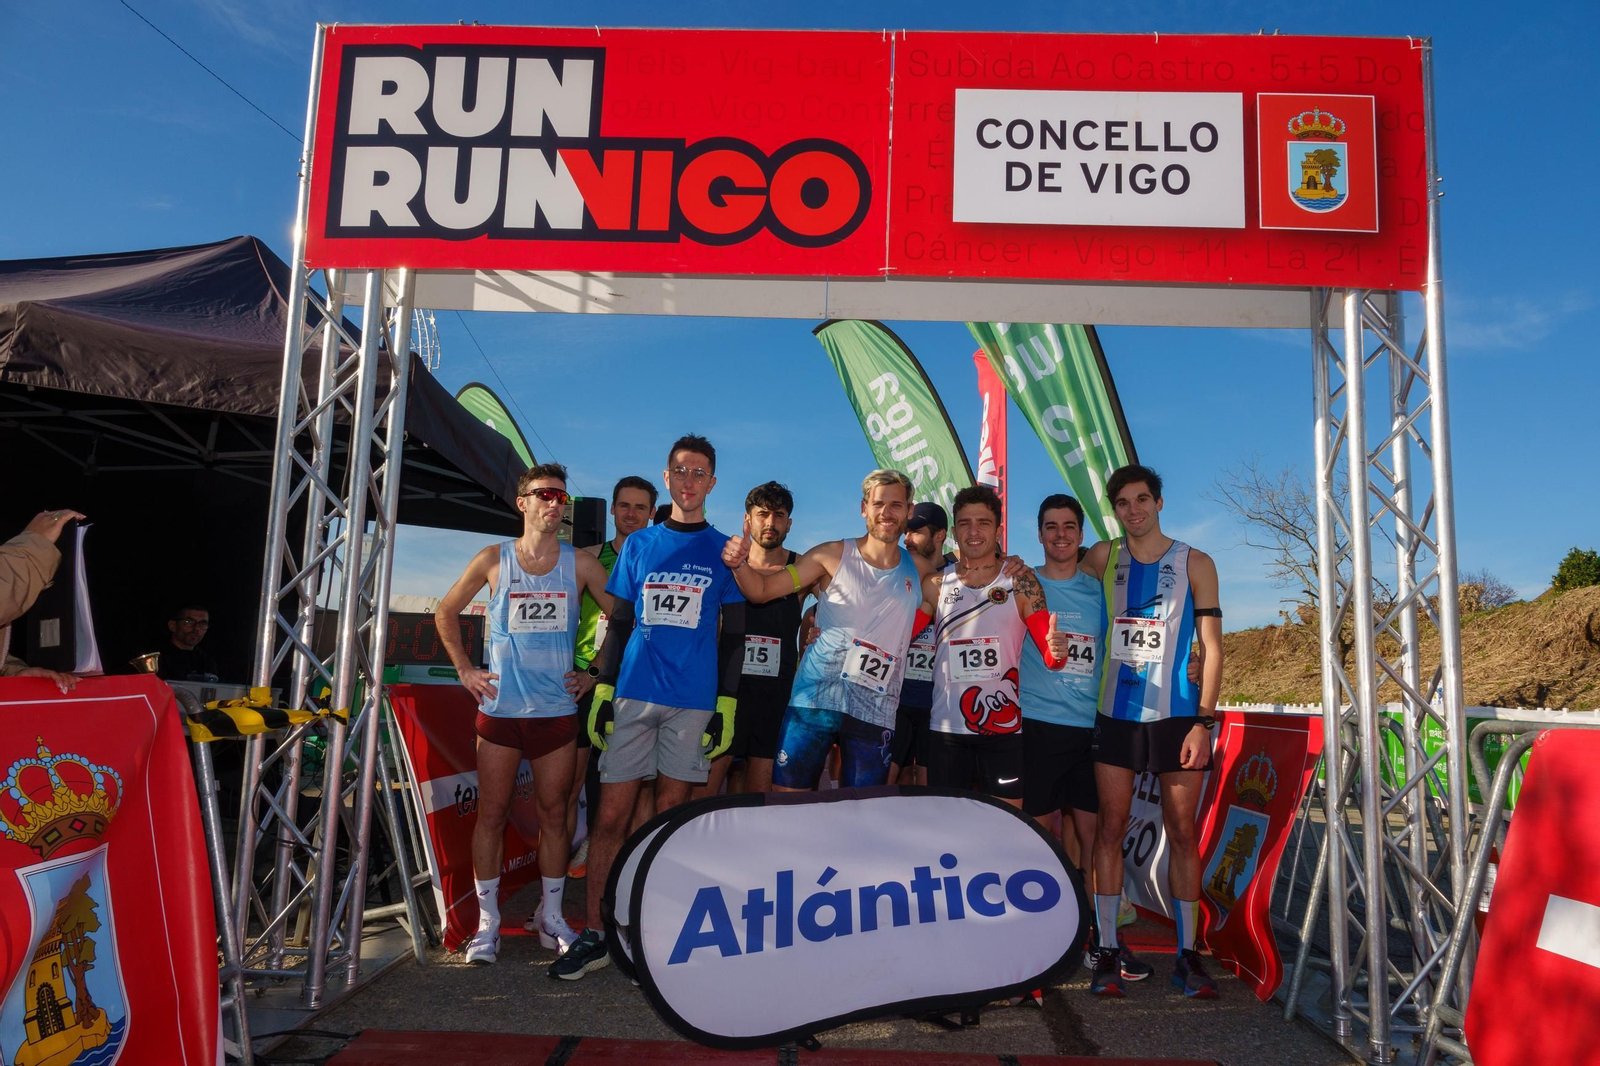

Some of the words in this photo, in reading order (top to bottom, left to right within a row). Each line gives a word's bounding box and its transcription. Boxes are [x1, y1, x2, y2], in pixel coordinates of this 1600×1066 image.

[908, 49, 1037, 80] Subida
[1050, 52, 1096, 80] Ao
[1111, 51, 1235, 82] Castro
[1269, 54, 1339, 84] 5+5
[1353, 56, 1401, 86] Do
[347, 56, 595, 138] RUN
[975, 118, 1219, 154] CONCELLO
[1004, 161, 1062, 193] DE
[1079, 163, 1192, 196] VIGO
[903, 231, 1038, 263] Cáncer
[1072, 235, 1155, 273] Vigo
[1266, 241, 1309, 271] La
[1322, 242, 1362, 272] 21
[518, 602, 557, 620] 122
[652, 593, 690, 613] 147
[1121, 629, 1161, 649] 143
[747, 646, 768, 663] 15
[959, 648, 998, 668] 138
[1068, 643, 1094, 664] 44
[859, 654, 890, 681] 121
[666, 853, 1062, 966] Atlántico
